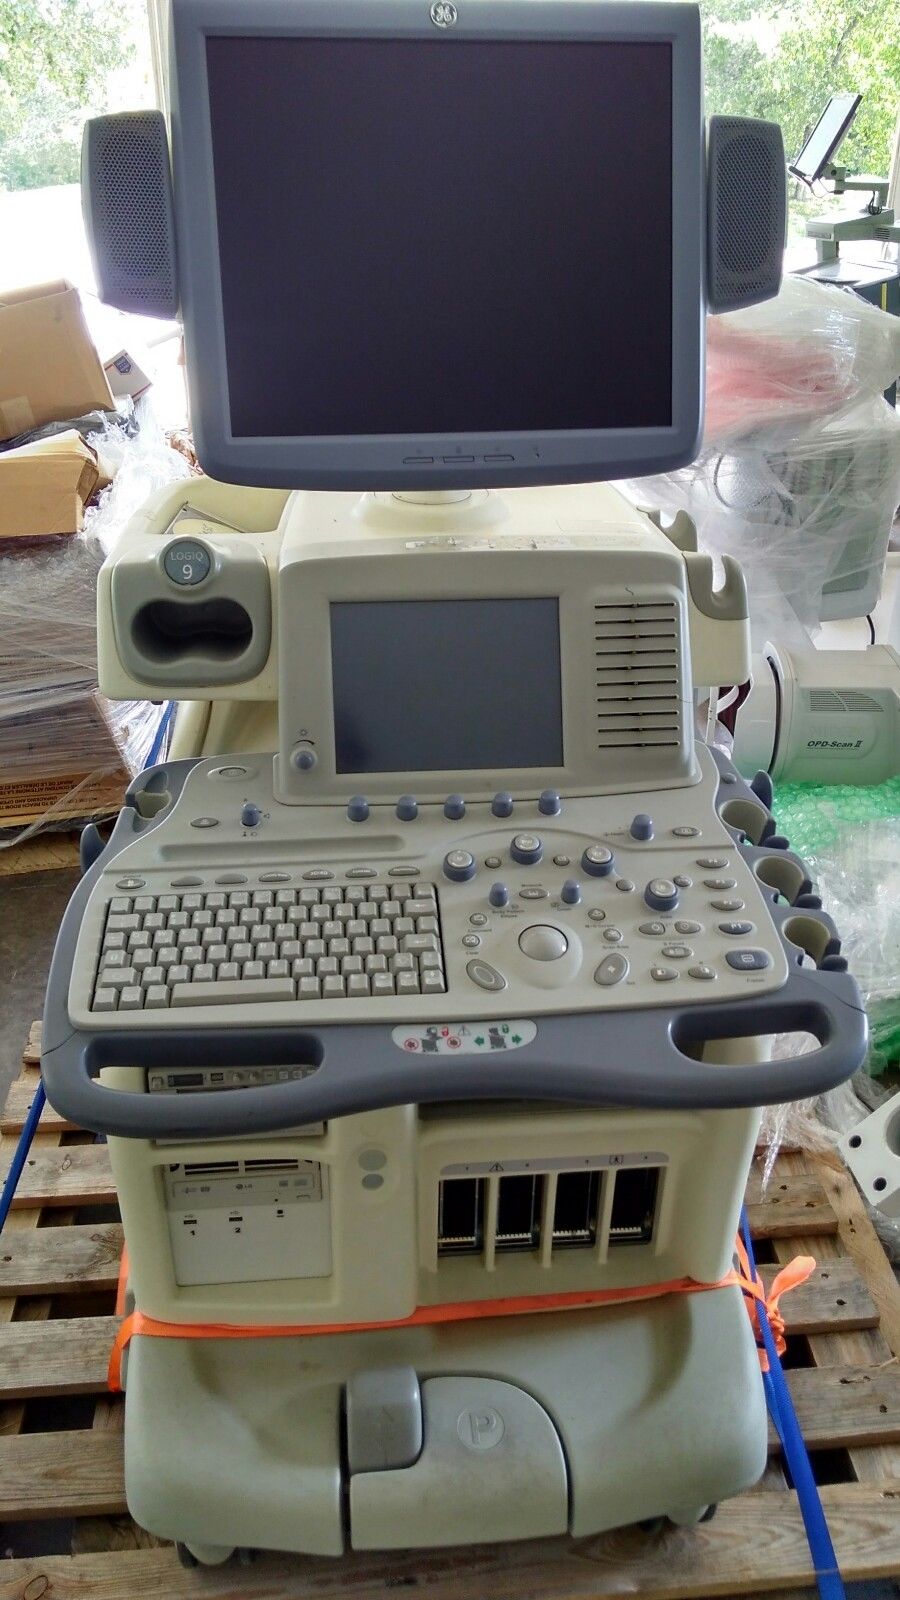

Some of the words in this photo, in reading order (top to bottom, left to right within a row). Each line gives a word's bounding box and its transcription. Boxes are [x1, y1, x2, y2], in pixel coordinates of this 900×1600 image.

[170, 552, 203, 561] LOGIQ
[183, 564, 192, 579] 9
[468, 1414, 497, 1444] P
